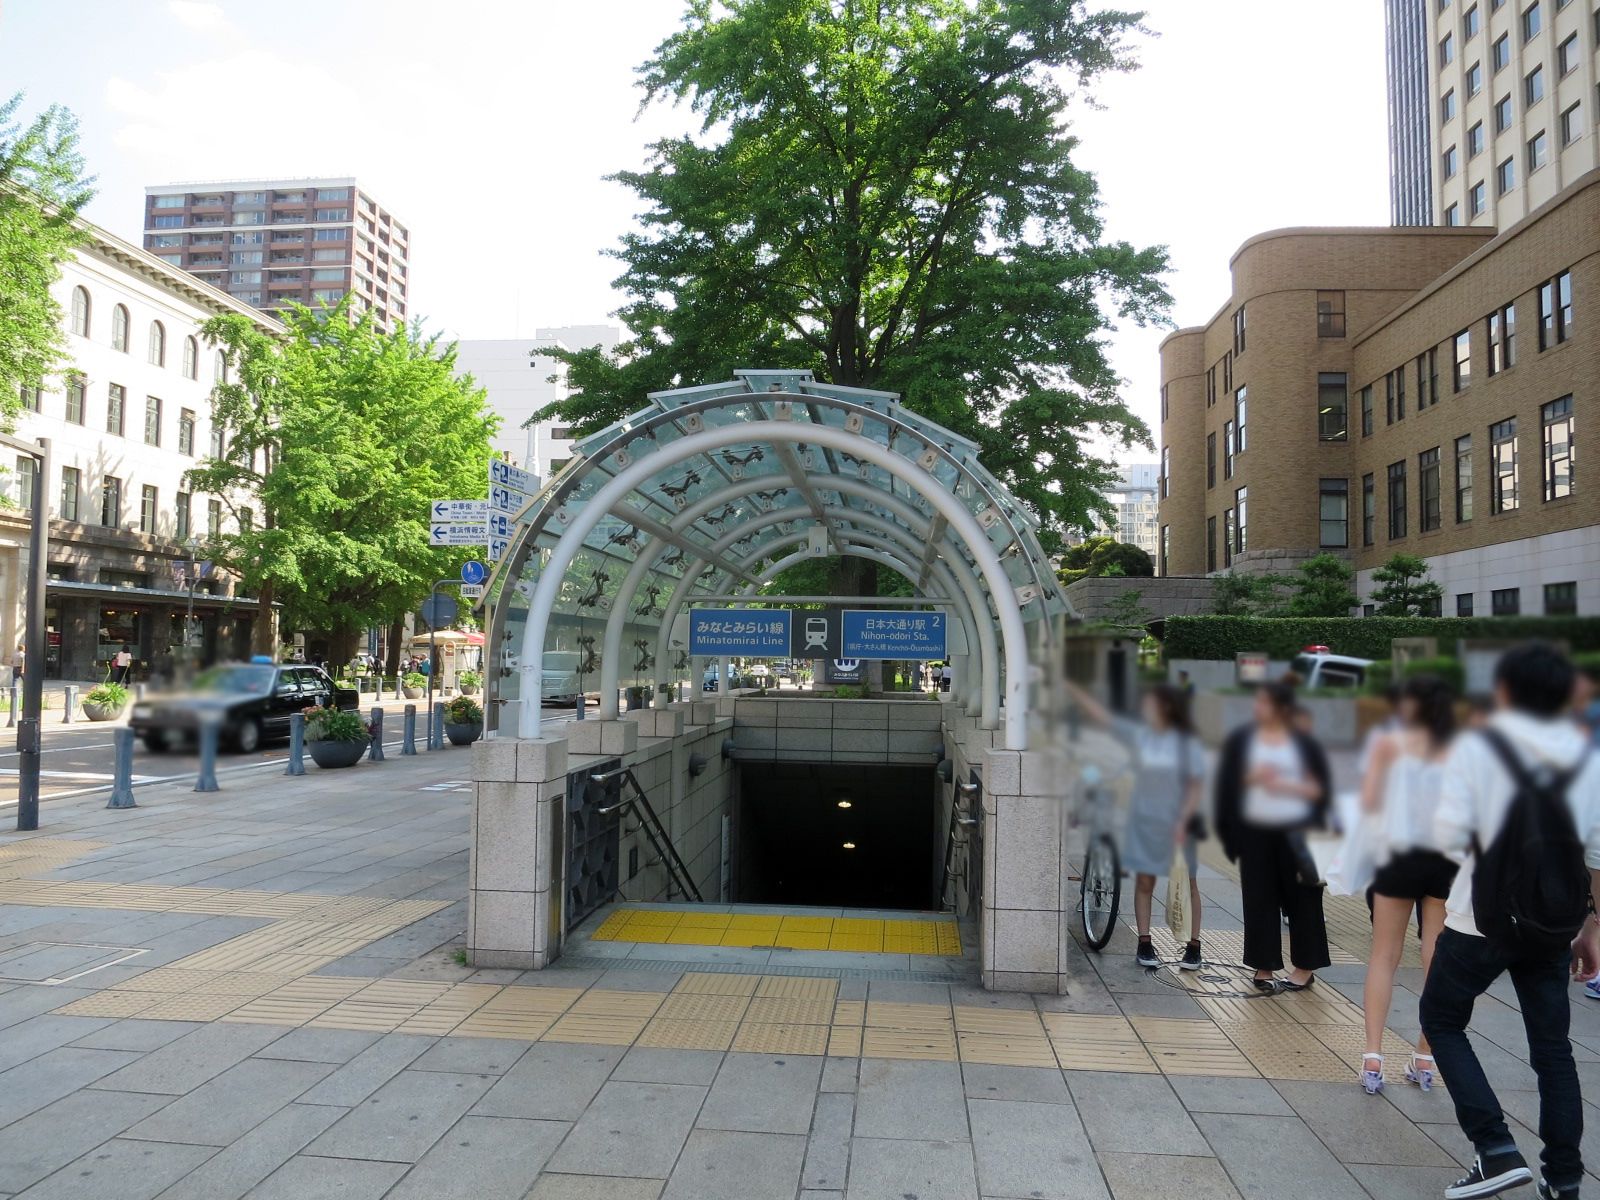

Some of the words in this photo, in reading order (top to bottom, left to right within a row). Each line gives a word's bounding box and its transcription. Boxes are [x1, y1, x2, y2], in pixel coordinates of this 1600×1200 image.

[449, 526, 488, 534] 横浜情報文
[866, 619, 926, 630] 日本大通り駅
[932, 616, 940, 627] 2
[697, 621, 784, 634] みなとみらい線
[697, 636, 759, 645] Minatomirai
[762, 637, 784, 645] Line
[913, 631, 930, 641] Sta.
